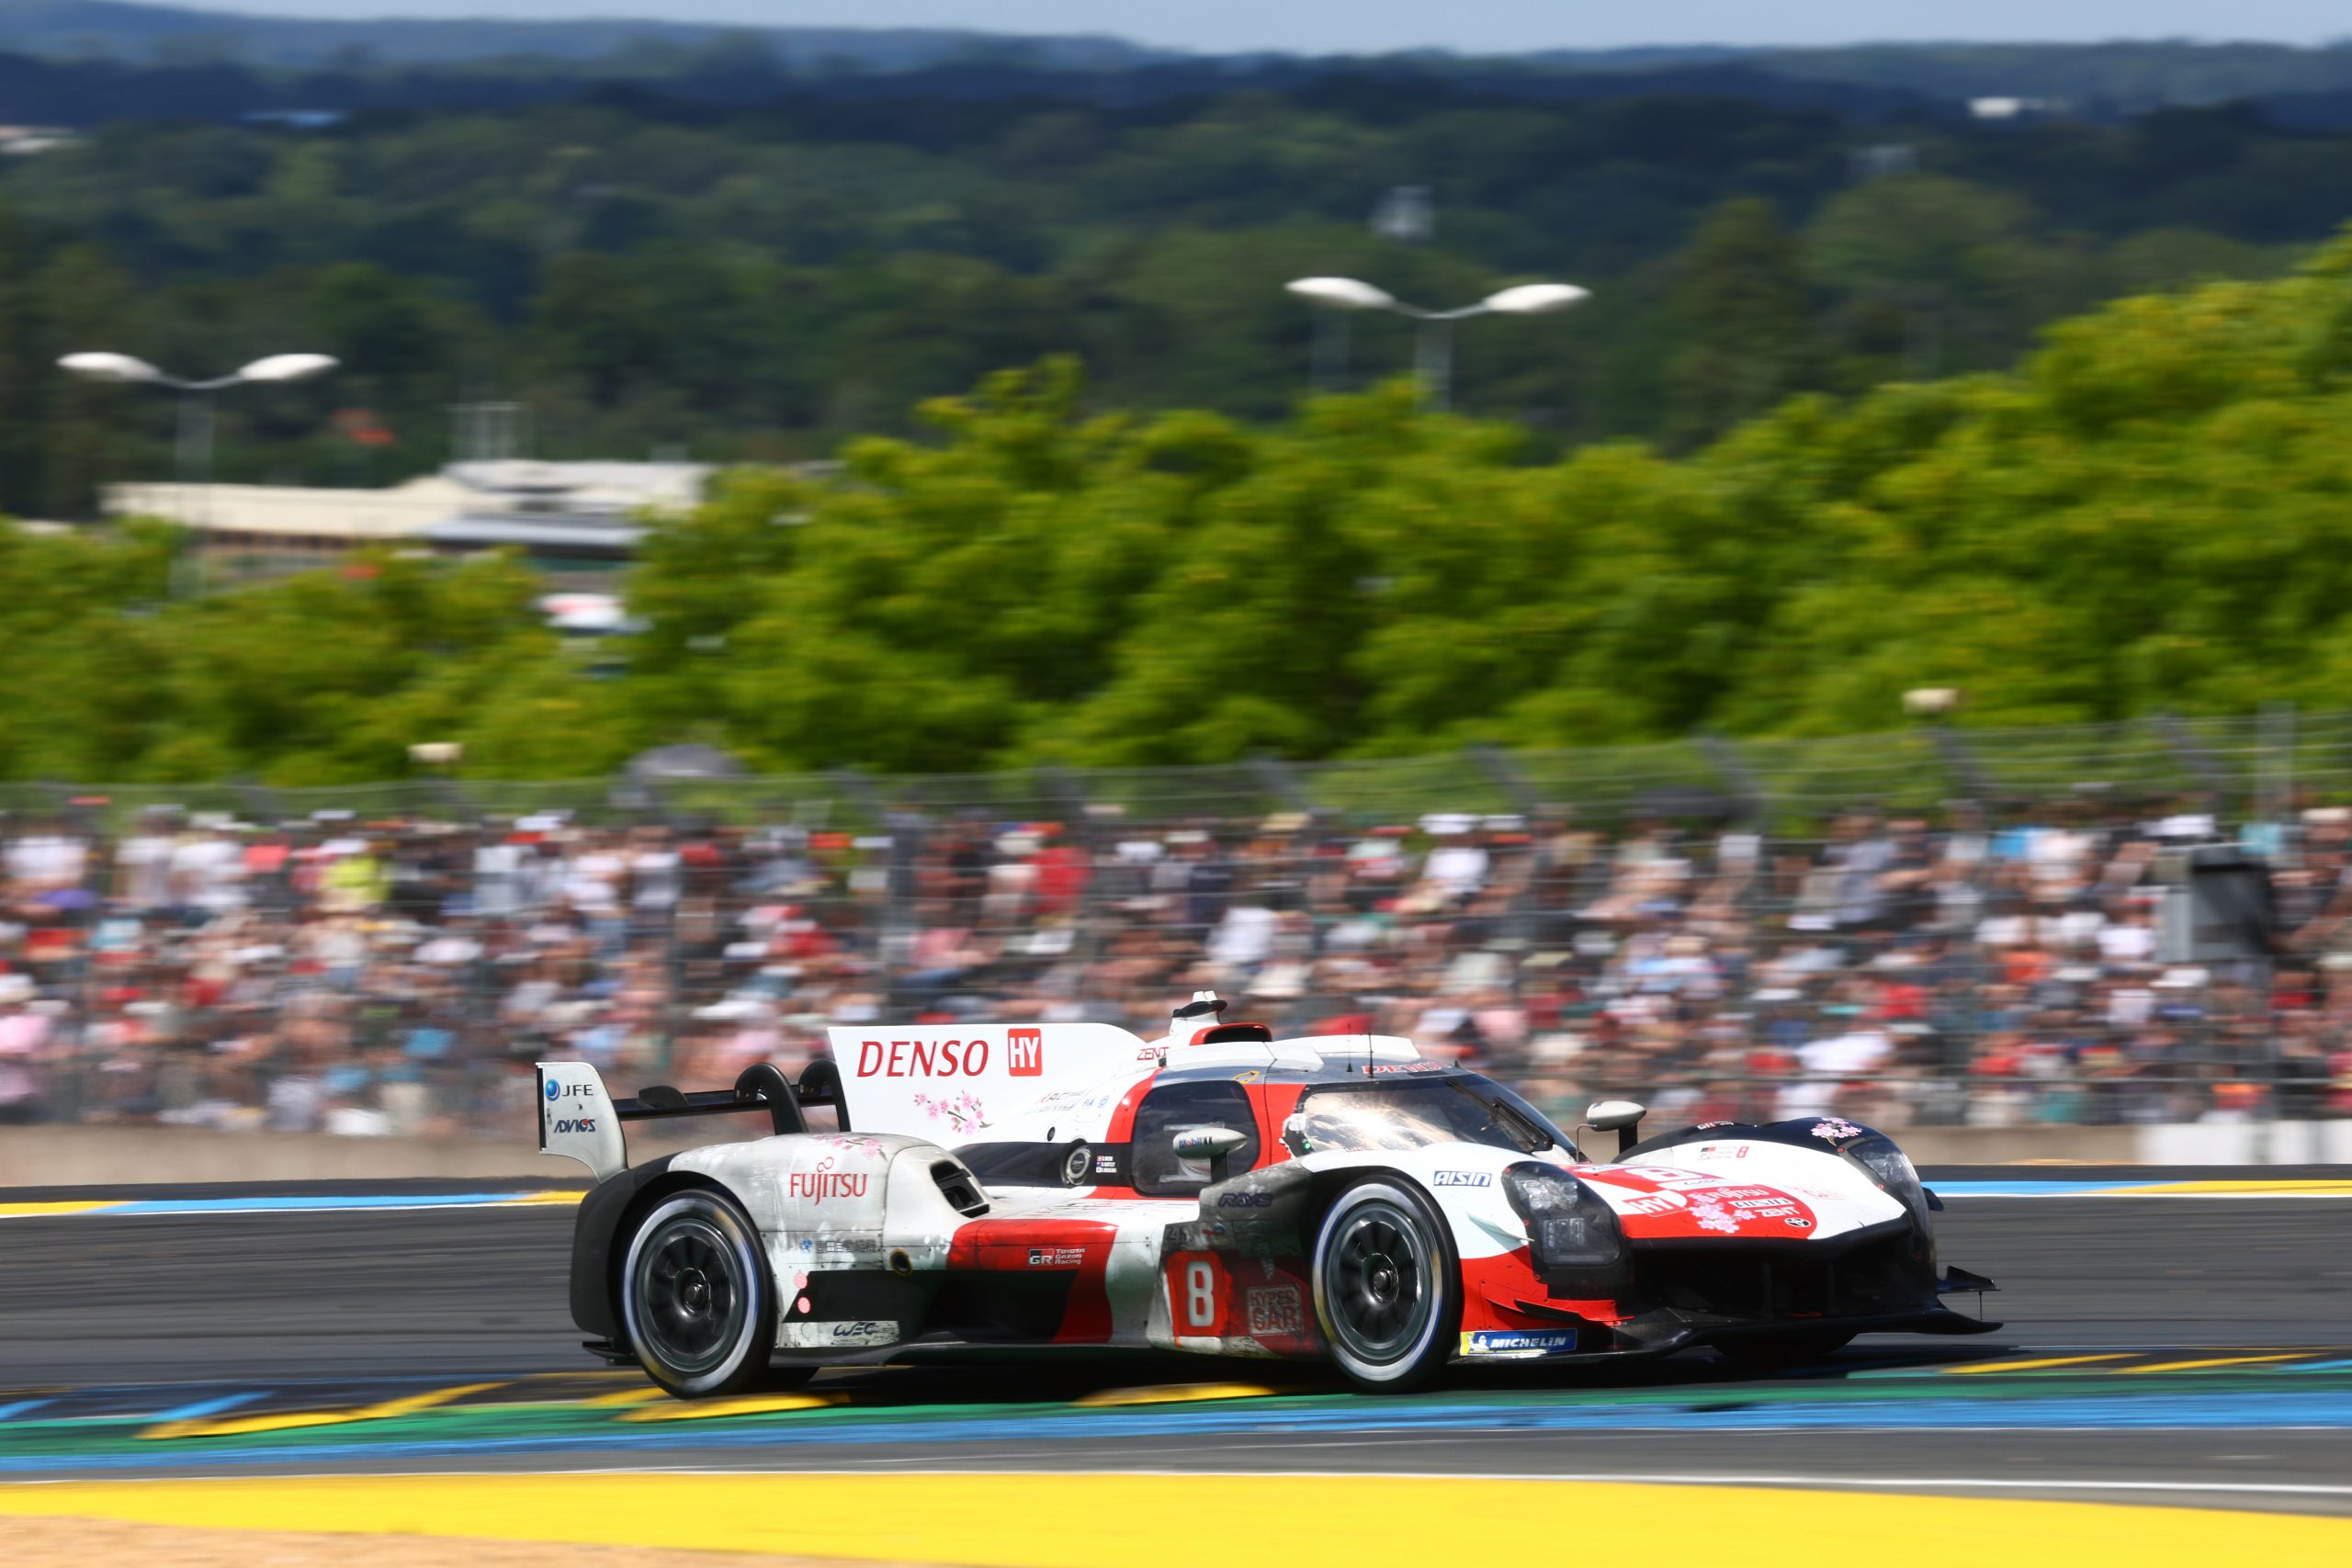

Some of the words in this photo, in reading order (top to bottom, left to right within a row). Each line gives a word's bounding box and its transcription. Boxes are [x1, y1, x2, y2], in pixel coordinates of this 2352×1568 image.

[857, 1040, 989, 1077] DENSO
[1009, 1036, 1039, 1068] HY
[1136, 1046, 1169, 1061] ZENT
[1362, 1061, 1452, 1074] DENS
[561, 1084, 594, 1097] JFE
[553, 1118, 595, 1134] ADVICS
[1179, 1137, 1203, 1147] Mobil
[1736, 1145, 1749, 1158] 8
[789, 1156, 868, 1206] FUJITSU
[1435, 1171, 1491, 1187] AISIN
[1218, 1193, 1273, 1208] RAYS
[1629, 1197, 1674, 1214] HY
[1755, 1207, 1801, 1217] ZENT
[1030, 1255, 1052, 1264] GR
[1186, 1260, 1215, 1327] 8
[1252, 1305, 1298, 1331] CAR
[833, 1321, 876, 1337] WEC
[1490, 1337, 1566, 1348] MICHELIN
